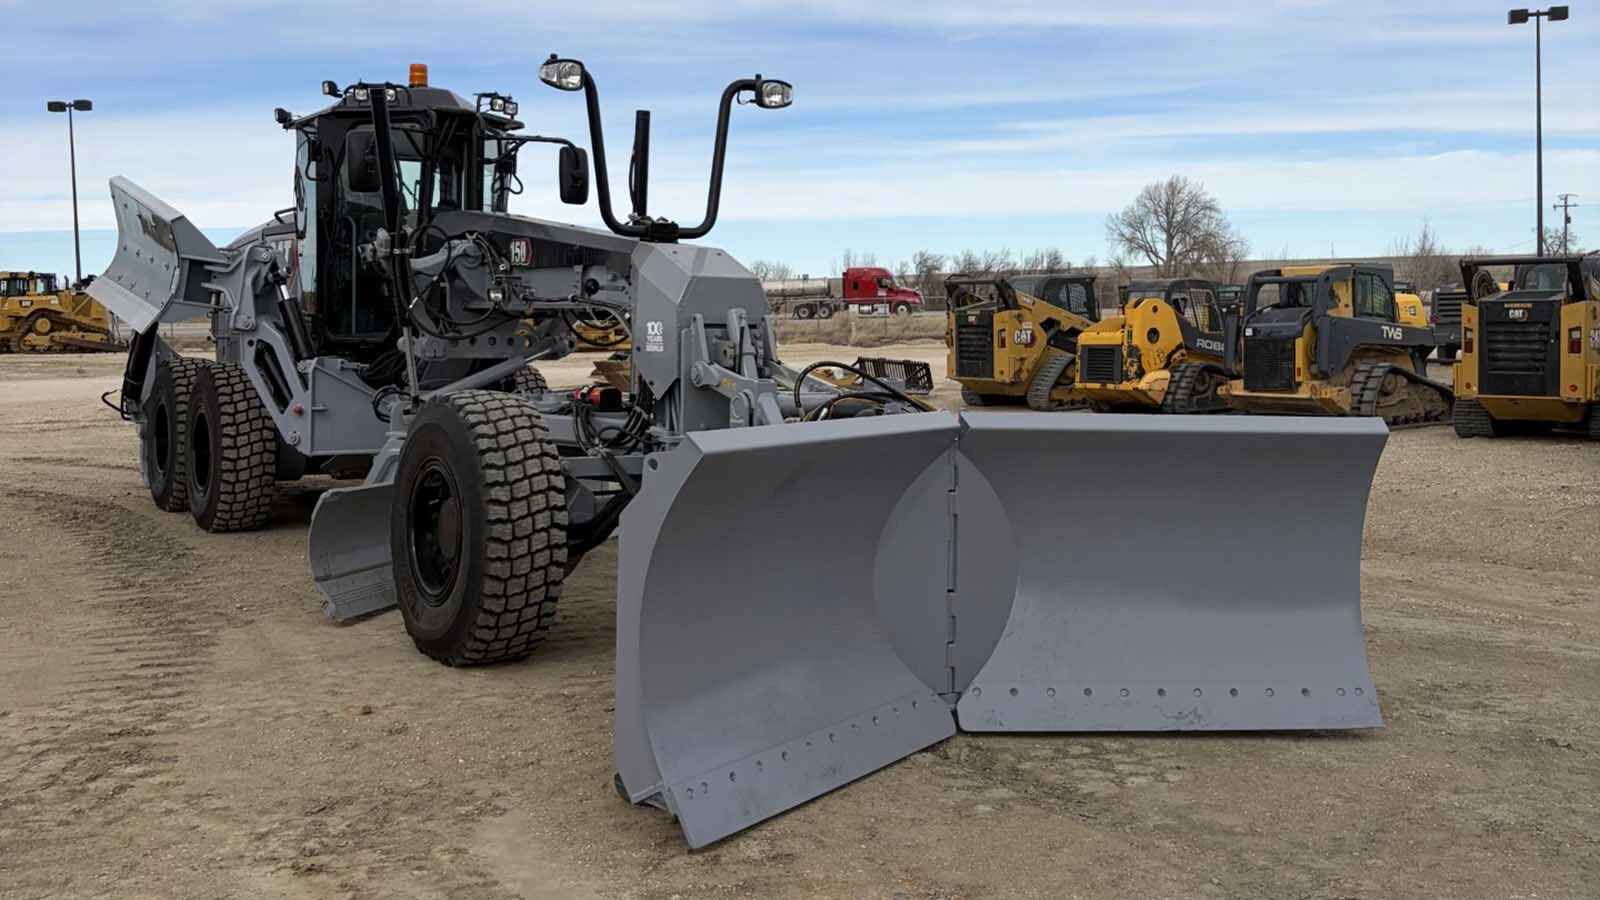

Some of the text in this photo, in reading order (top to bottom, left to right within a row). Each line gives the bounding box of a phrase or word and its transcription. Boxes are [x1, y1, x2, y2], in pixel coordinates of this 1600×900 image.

[509, 240, 527, 263] 150
[1508, 309, 1523, 319] CAT
[1014, 330, 1032, 344] CAT
